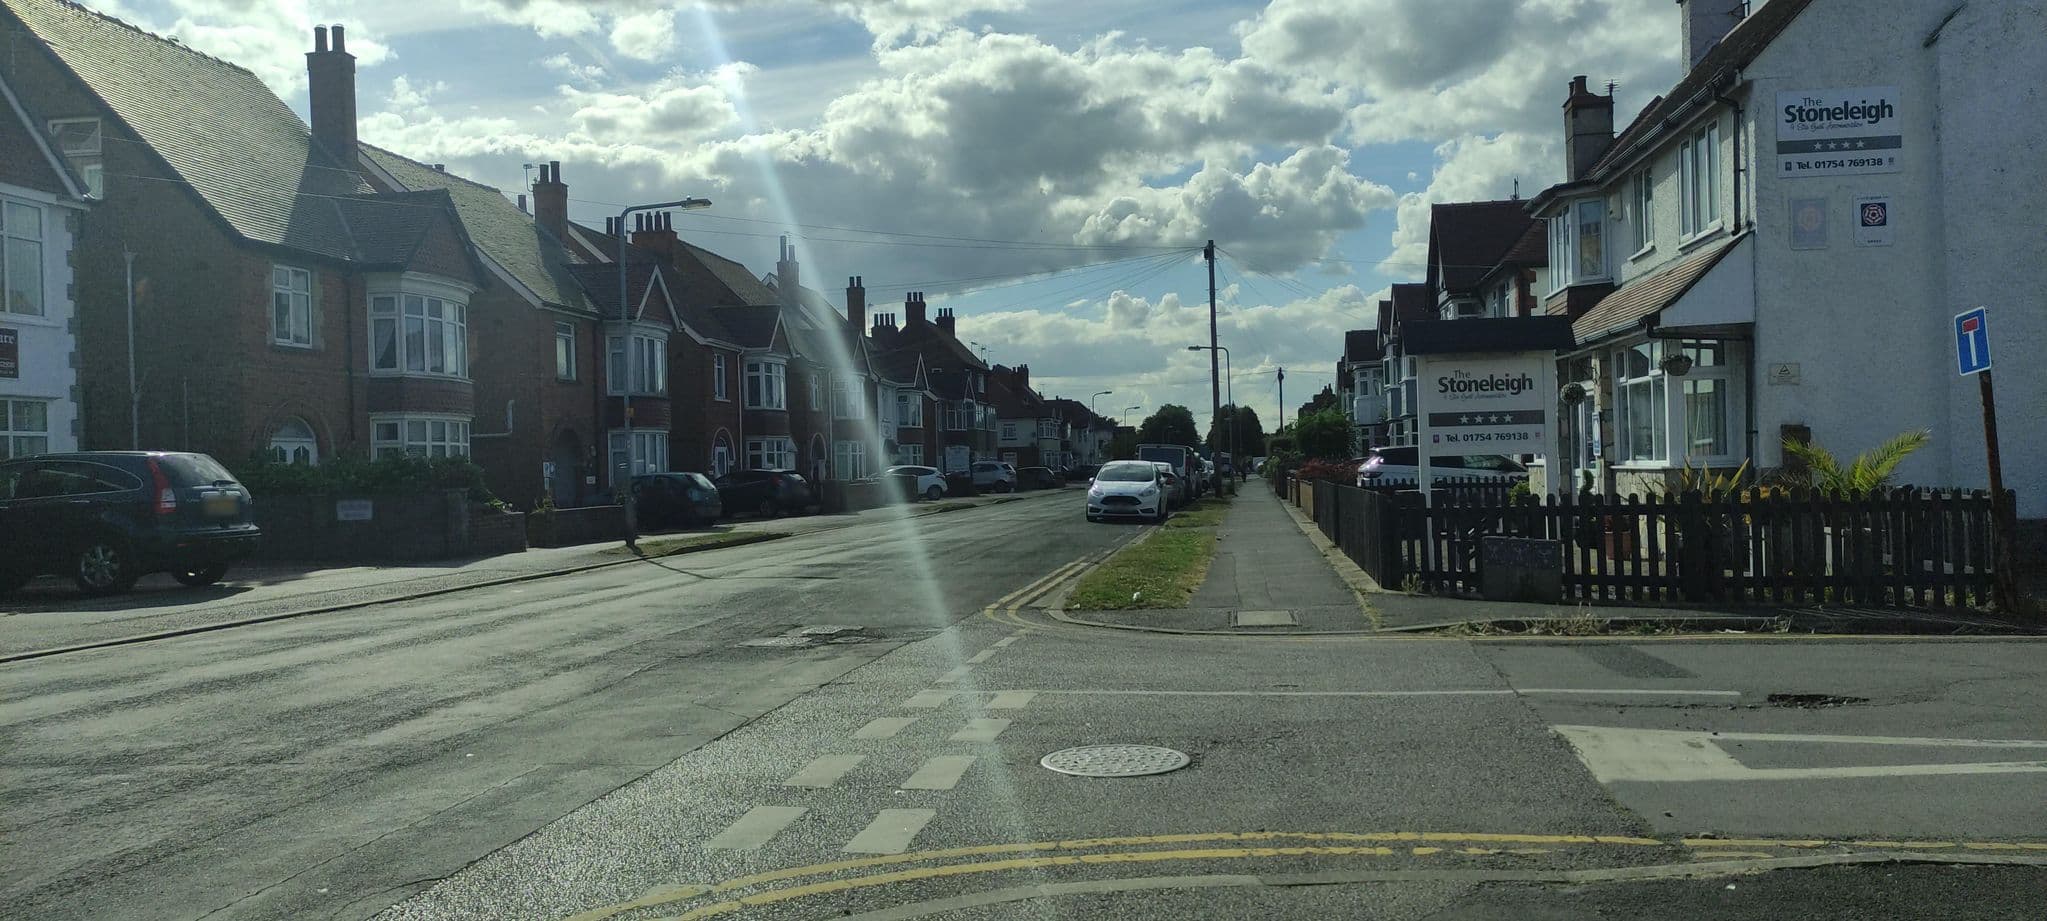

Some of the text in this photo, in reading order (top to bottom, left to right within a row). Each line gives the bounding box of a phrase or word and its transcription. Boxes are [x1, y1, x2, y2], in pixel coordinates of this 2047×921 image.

[1803, 97, 1822, 106] The
[1784, 99, 1893, 124] Stoneleigh
[1797, 158, 1883, 170] Tel. 01754 769138
[1454, 369, 1470, 379] The
[1438, 372, 1533, 395] Stoneleigh
[1445, 432, 1529, 442] Tel. 01754 769138
